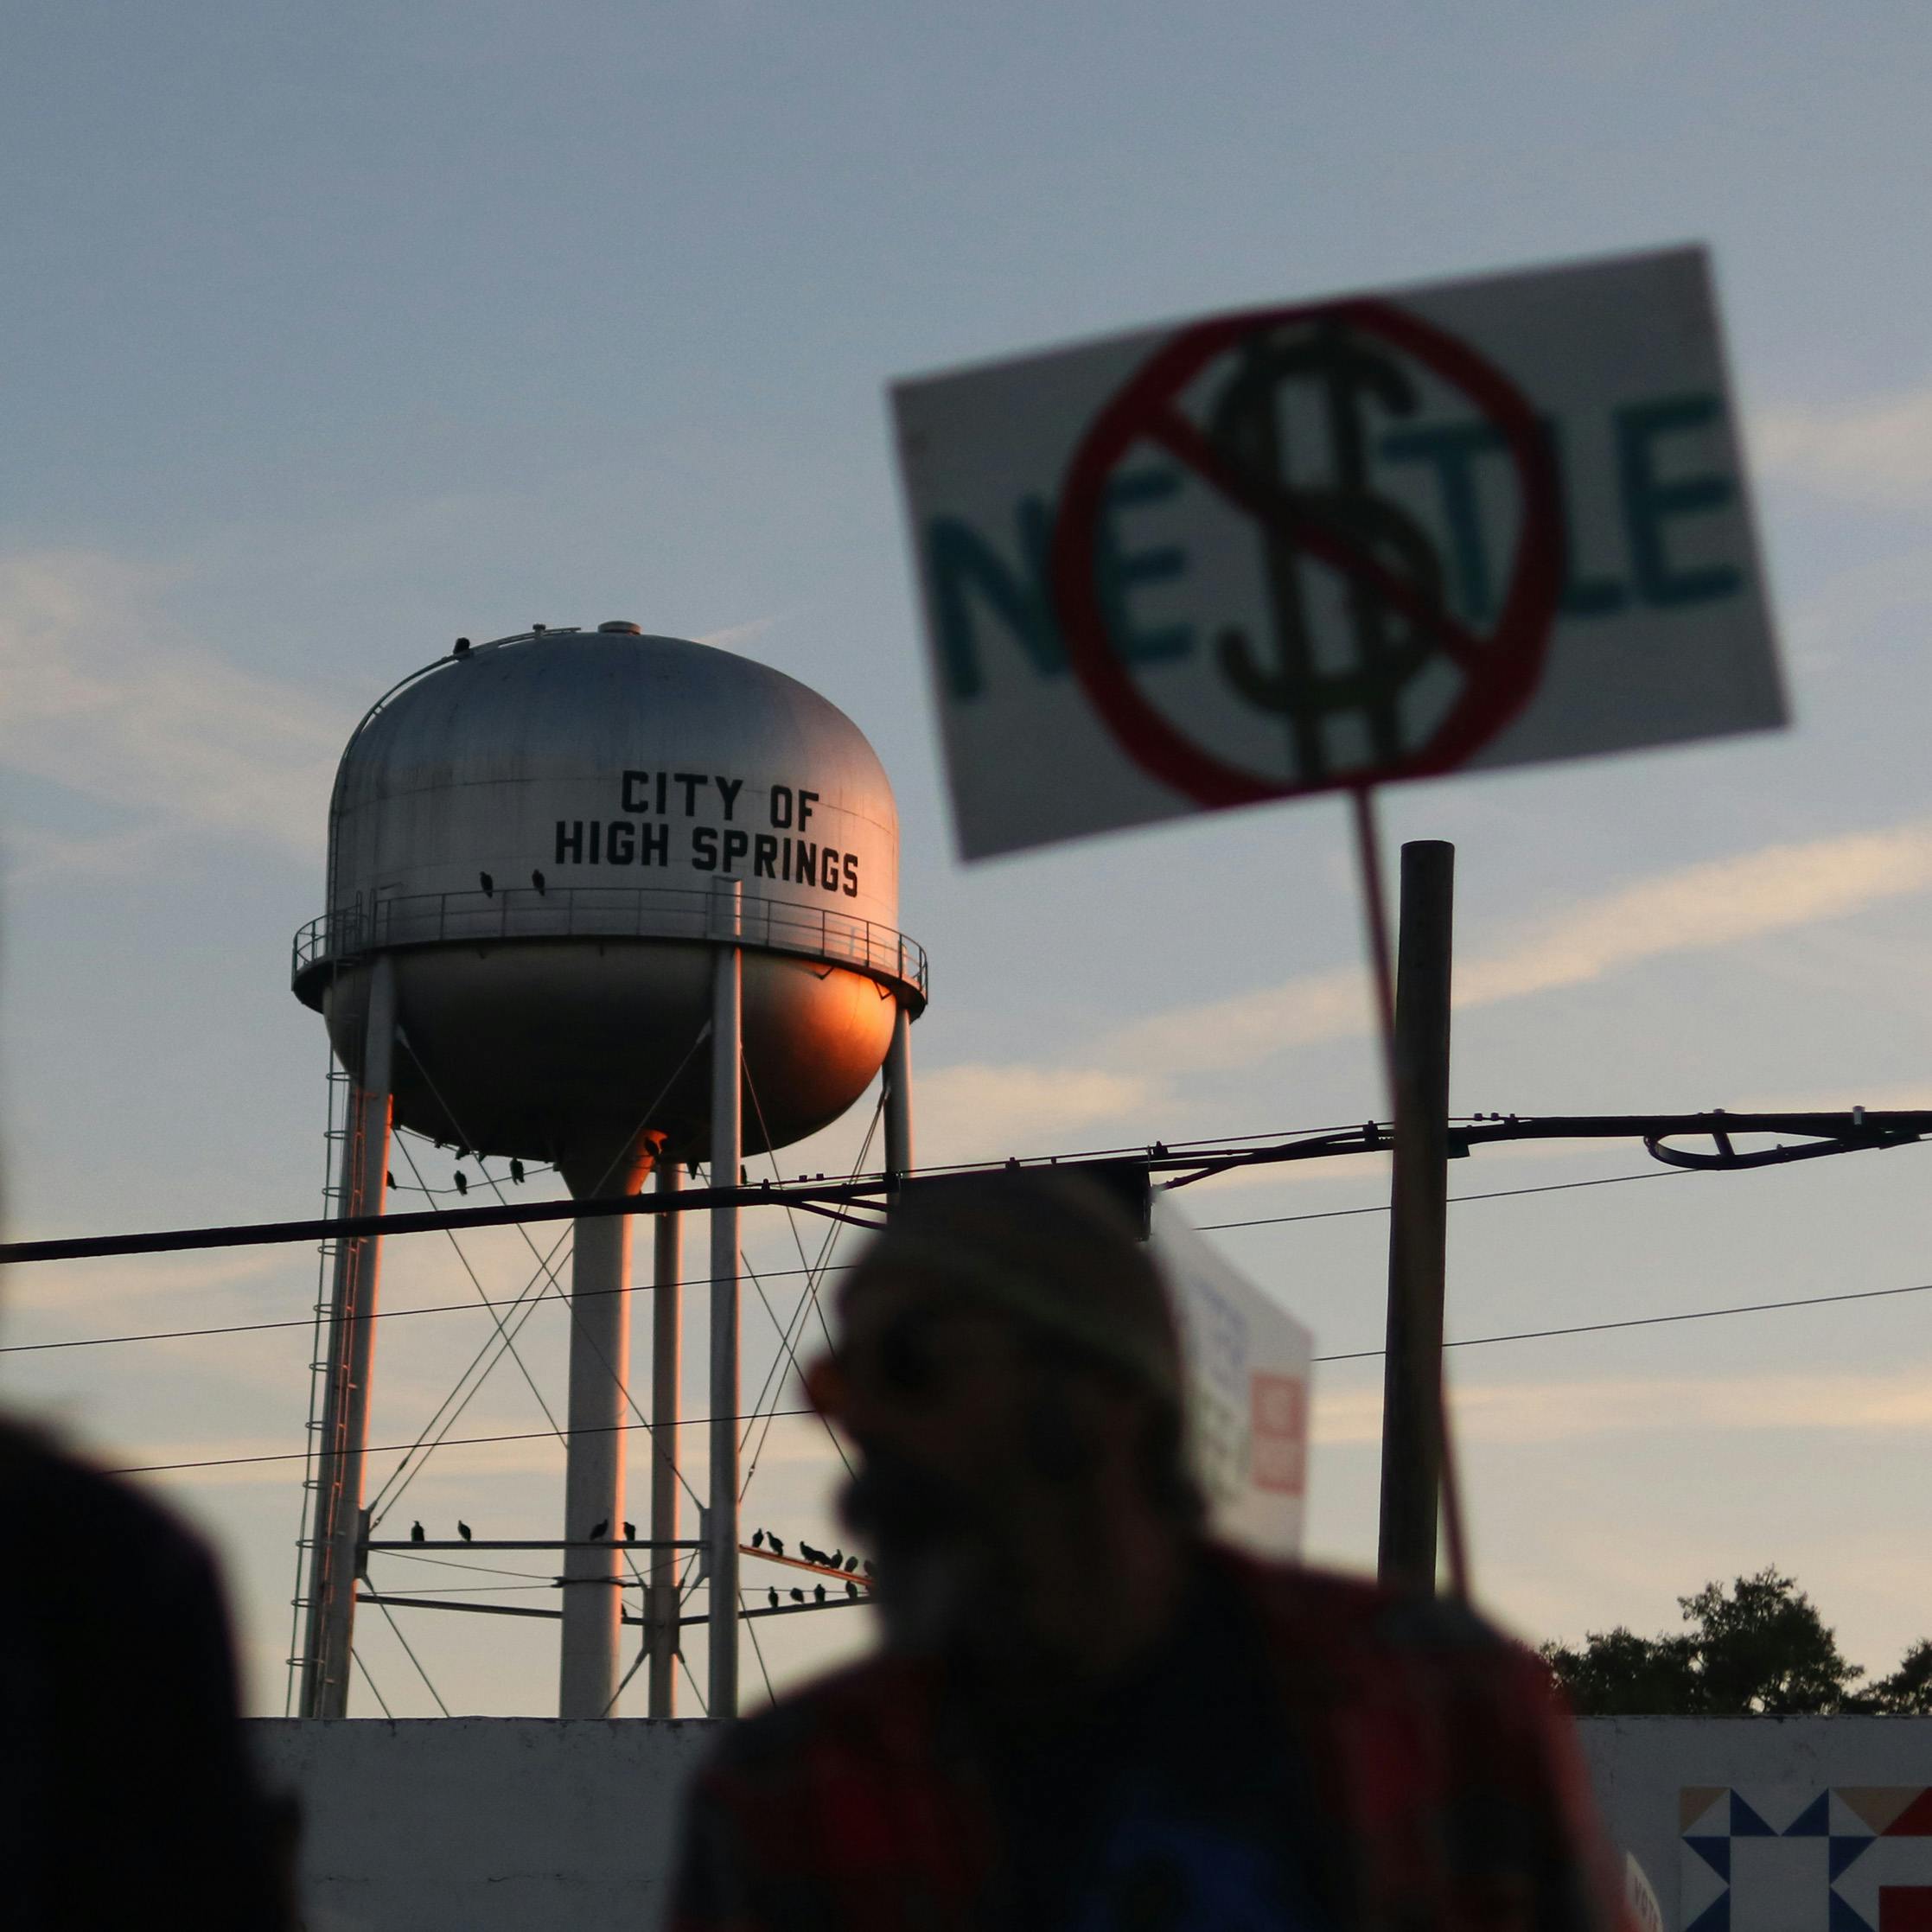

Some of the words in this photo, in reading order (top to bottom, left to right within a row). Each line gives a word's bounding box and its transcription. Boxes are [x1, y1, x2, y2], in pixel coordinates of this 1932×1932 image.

[622, 770, 743, 821] CITY
[769, 785, 819, 832] OF
[555, 820, 669, 867] HIGH
[692, 826, 859, 898] SPRINGS
